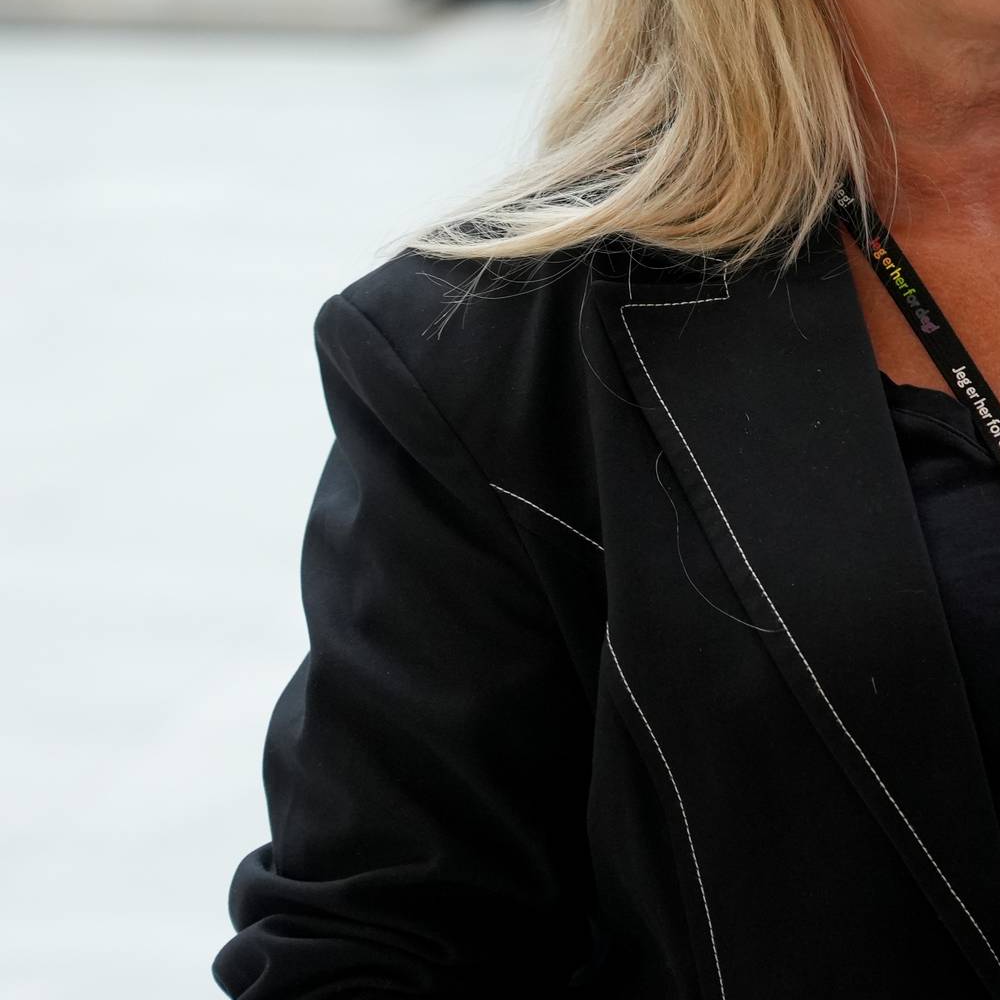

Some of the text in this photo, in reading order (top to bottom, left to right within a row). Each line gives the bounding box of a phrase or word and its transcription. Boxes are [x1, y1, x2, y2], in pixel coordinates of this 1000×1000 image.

[882, 257, 896, 270] er
[890, 267, 909, 290] her
[903, 288, 920, 308] for
[952, 365, 972, 388] Jeg
[966, 386, 980, 399] er
[973, 398, 993, 419] her
